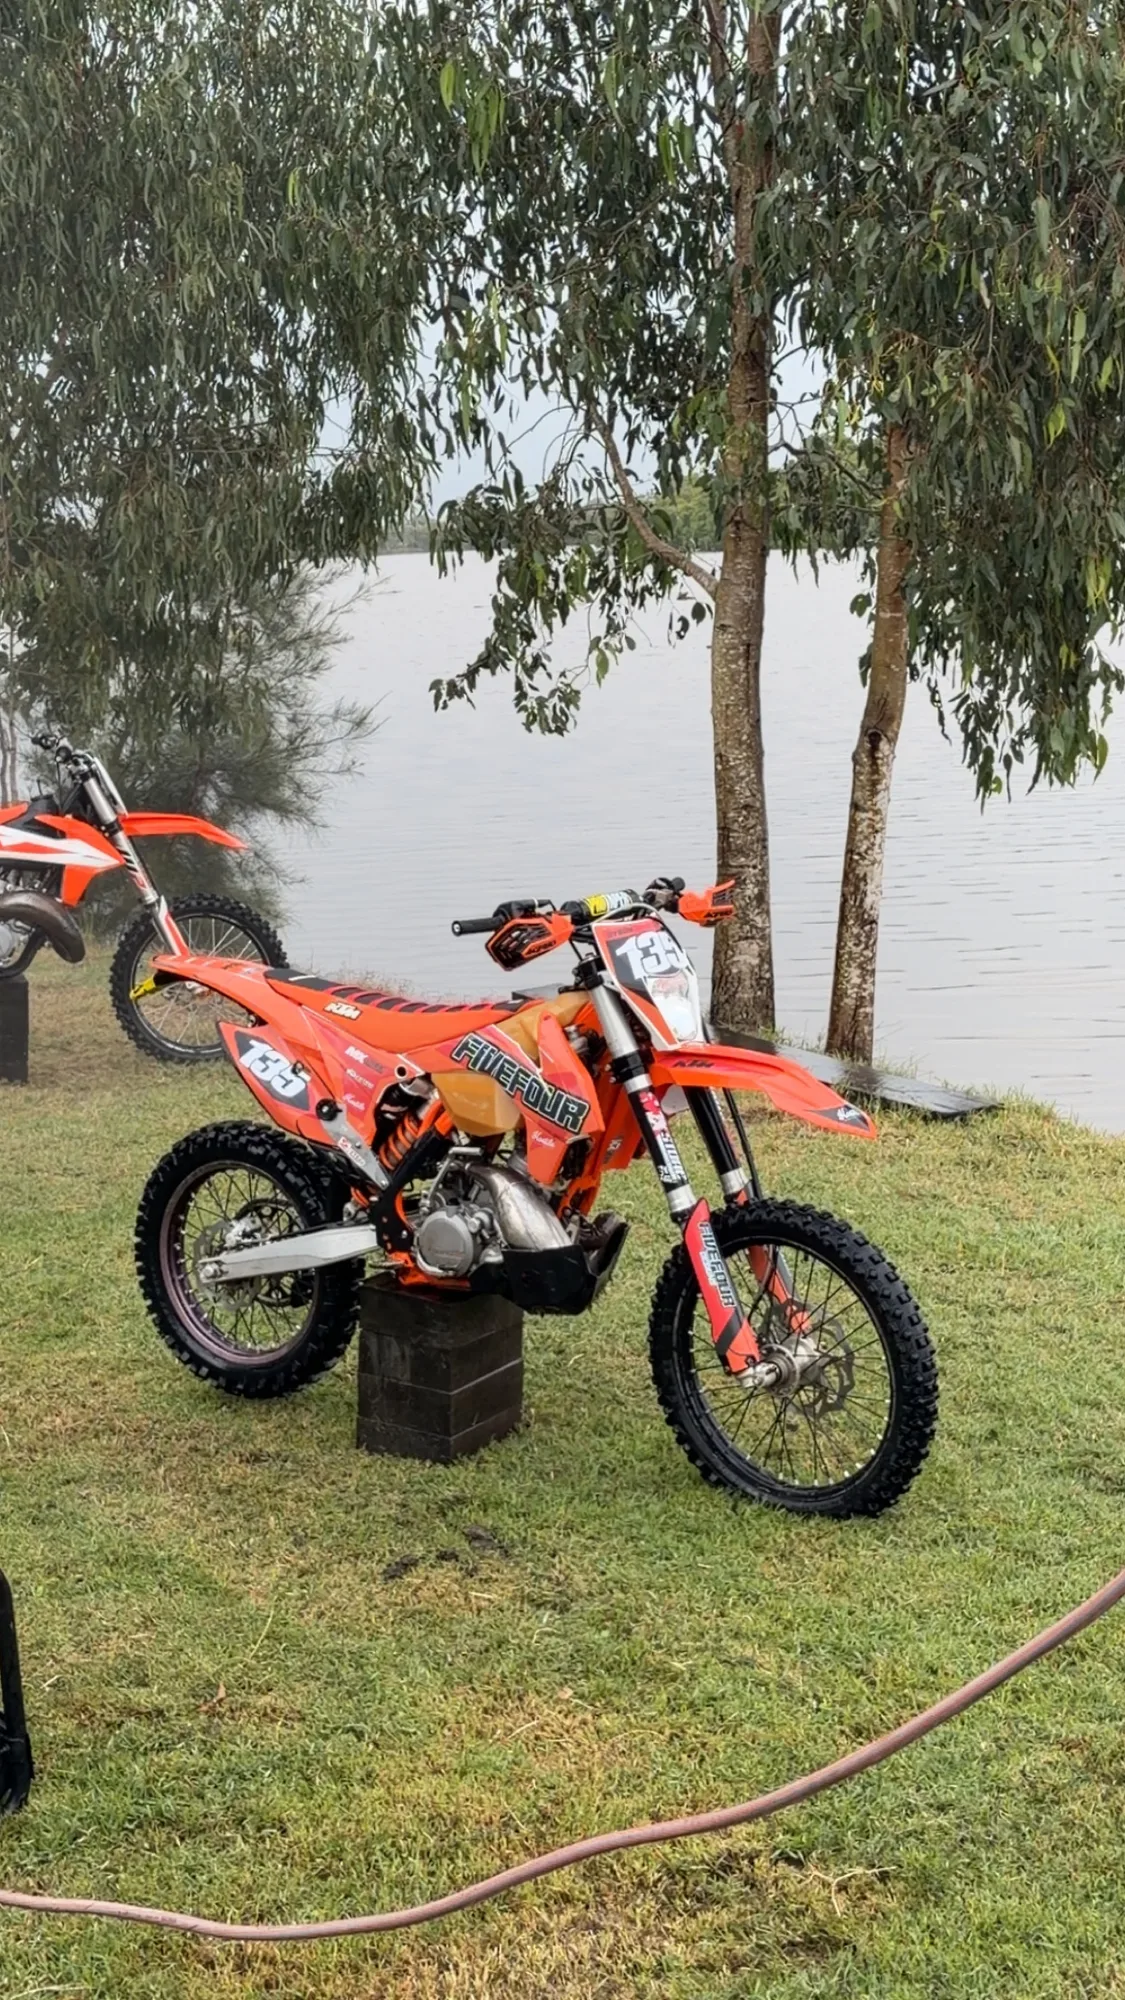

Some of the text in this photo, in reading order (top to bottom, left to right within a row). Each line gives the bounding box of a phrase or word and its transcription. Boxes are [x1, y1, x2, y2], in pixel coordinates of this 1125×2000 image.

[324, 1001, 362, 1020] KTM
[239, 1040, 311, 1098] 135
[452, 1032, 590, 1134] FIVEFOUR
[698, 1221, 736, 1308] FIVEFOUR
